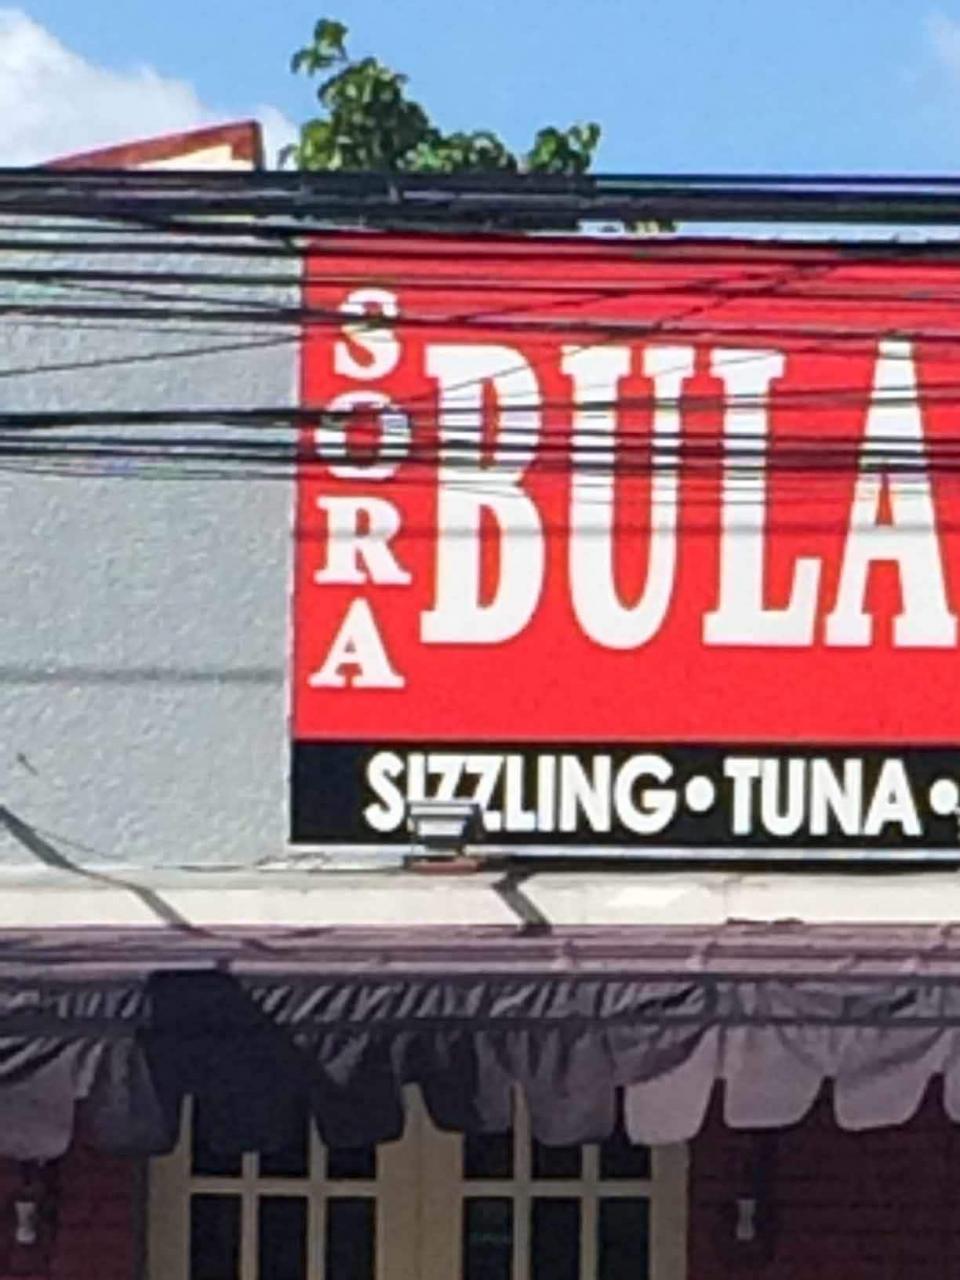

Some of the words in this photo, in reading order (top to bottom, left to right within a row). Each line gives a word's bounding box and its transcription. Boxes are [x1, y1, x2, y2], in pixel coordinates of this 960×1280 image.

[308, 287, 412, 689] SORA
[362, 751, 678, 835] SIZZLING
[722, 756, 923, 837] TUNA
